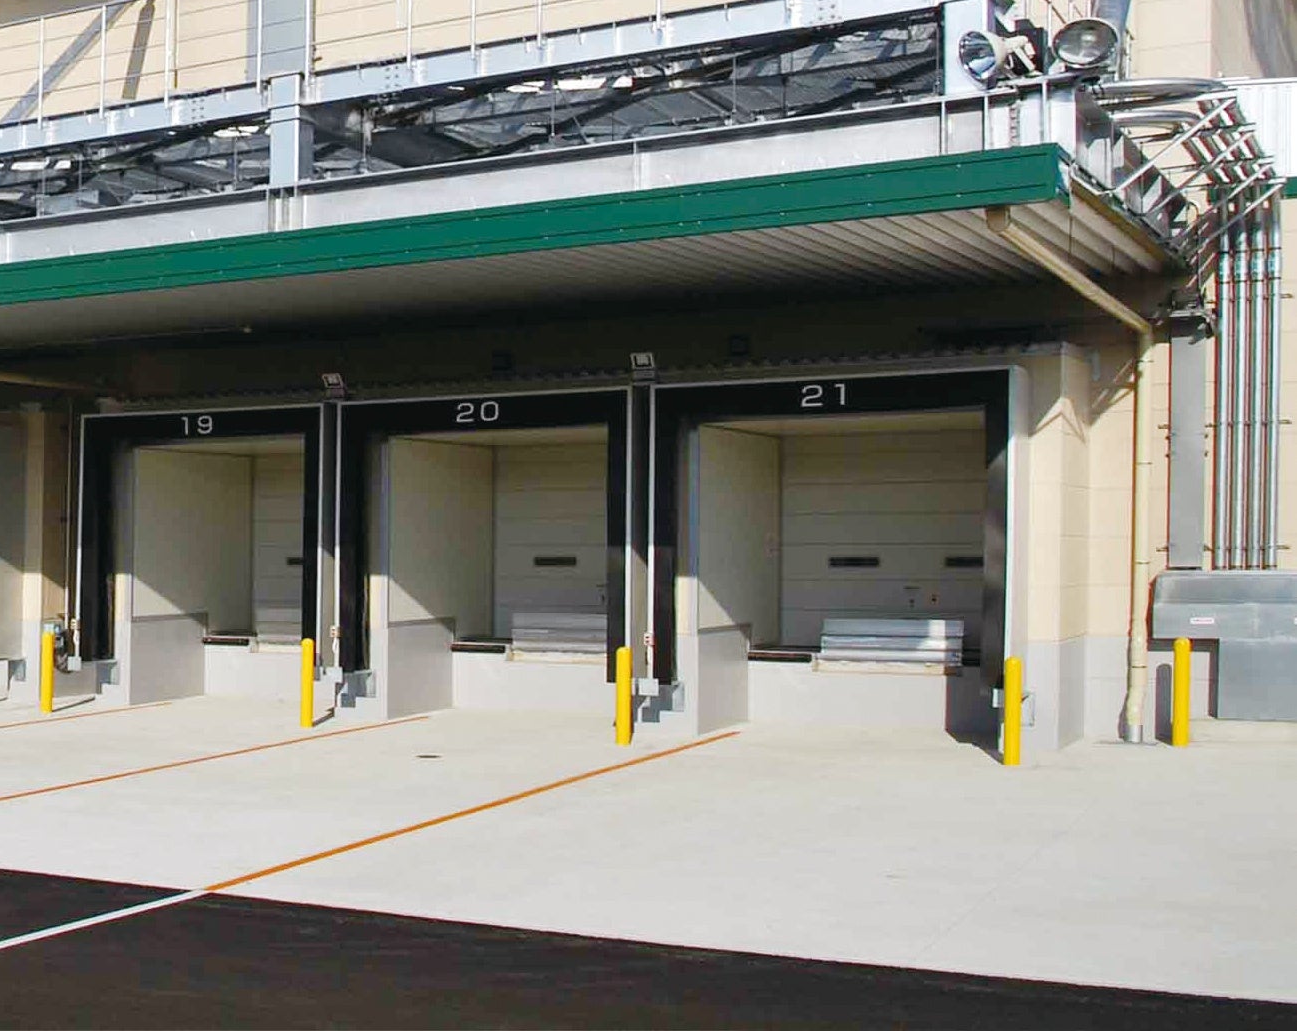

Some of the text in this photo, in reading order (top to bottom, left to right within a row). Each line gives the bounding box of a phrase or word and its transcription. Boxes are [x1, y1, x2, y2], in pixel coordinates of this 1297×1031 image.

[800, 383, 846, 408] 21
[455, 400, 500, 423] 20
[180, 414, 213, 435] 19
